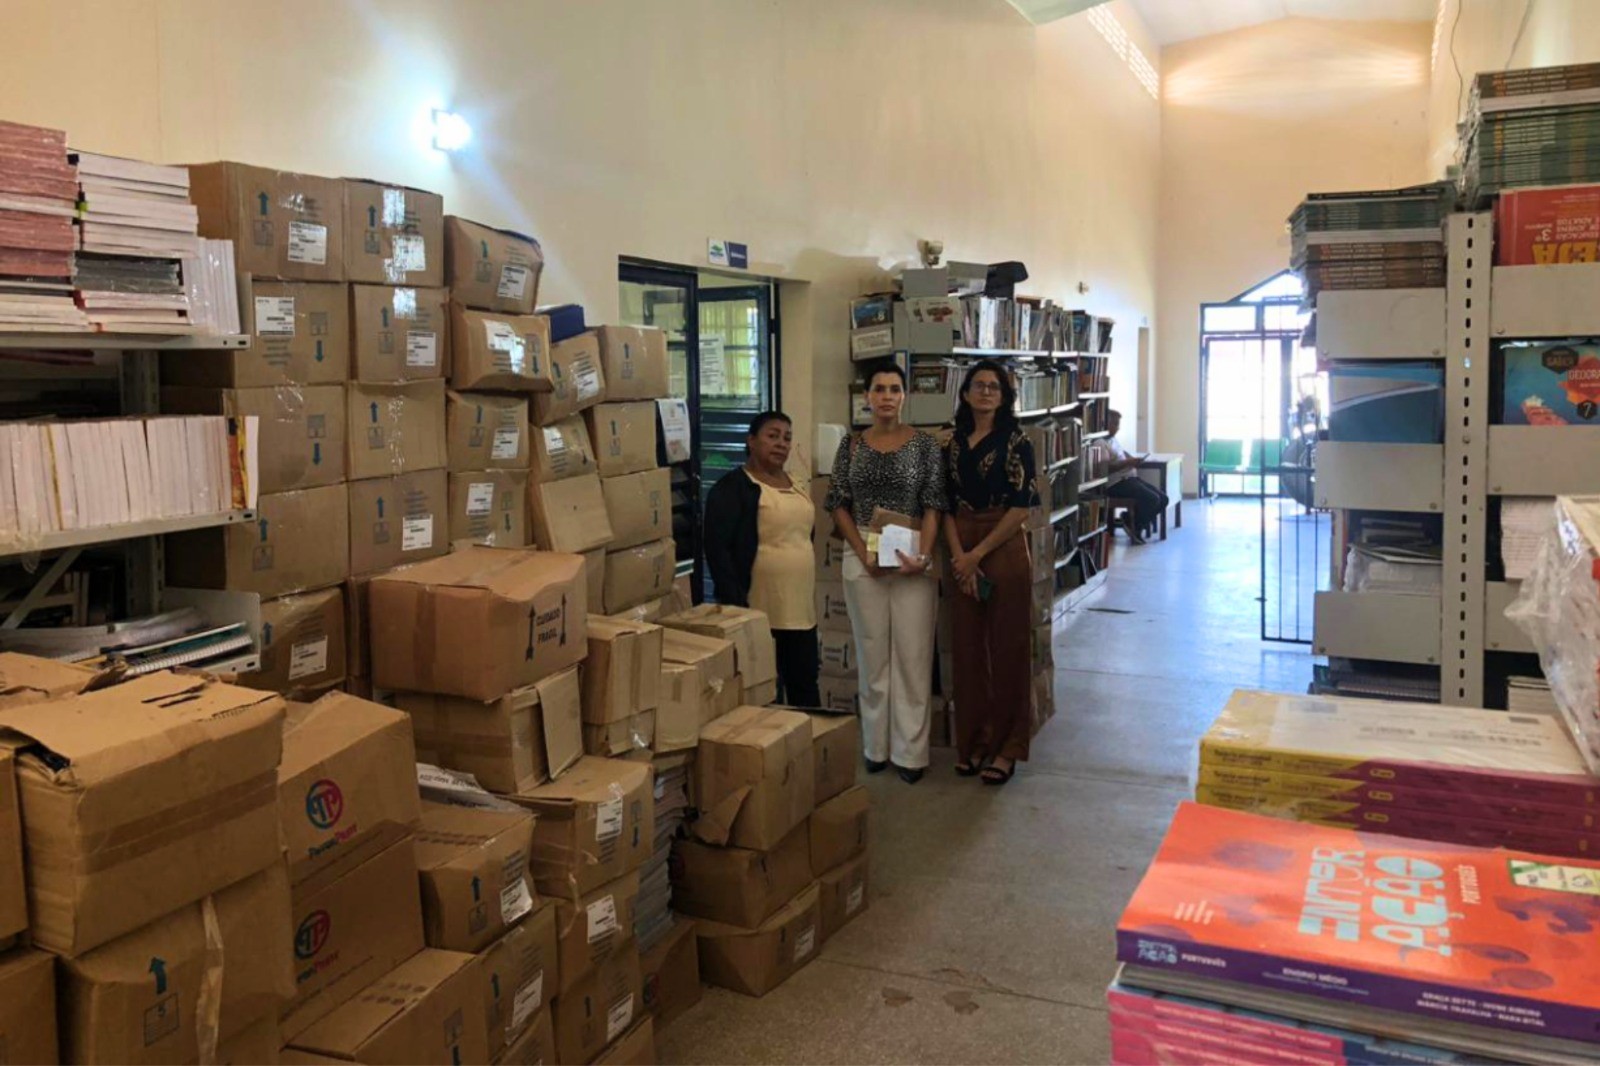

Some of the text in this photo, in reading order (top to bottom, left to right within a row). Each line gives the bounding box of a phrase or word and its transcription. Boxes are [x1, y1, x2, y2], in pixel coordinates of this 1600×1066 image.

[1557, 217, 1592, 225] ADULTOS
[1555, 231, 1599, 241] EDUCAÇÃO
[1532, 241, 1598, 264] EJA
[1583, 402, 1592, 418] 7
[1453, 863, 1481, 905] PORTUGUÊS
[1282, 967, 1317, 981] ENSINO
[1318, 973, 1348, 986] MÉDIO
